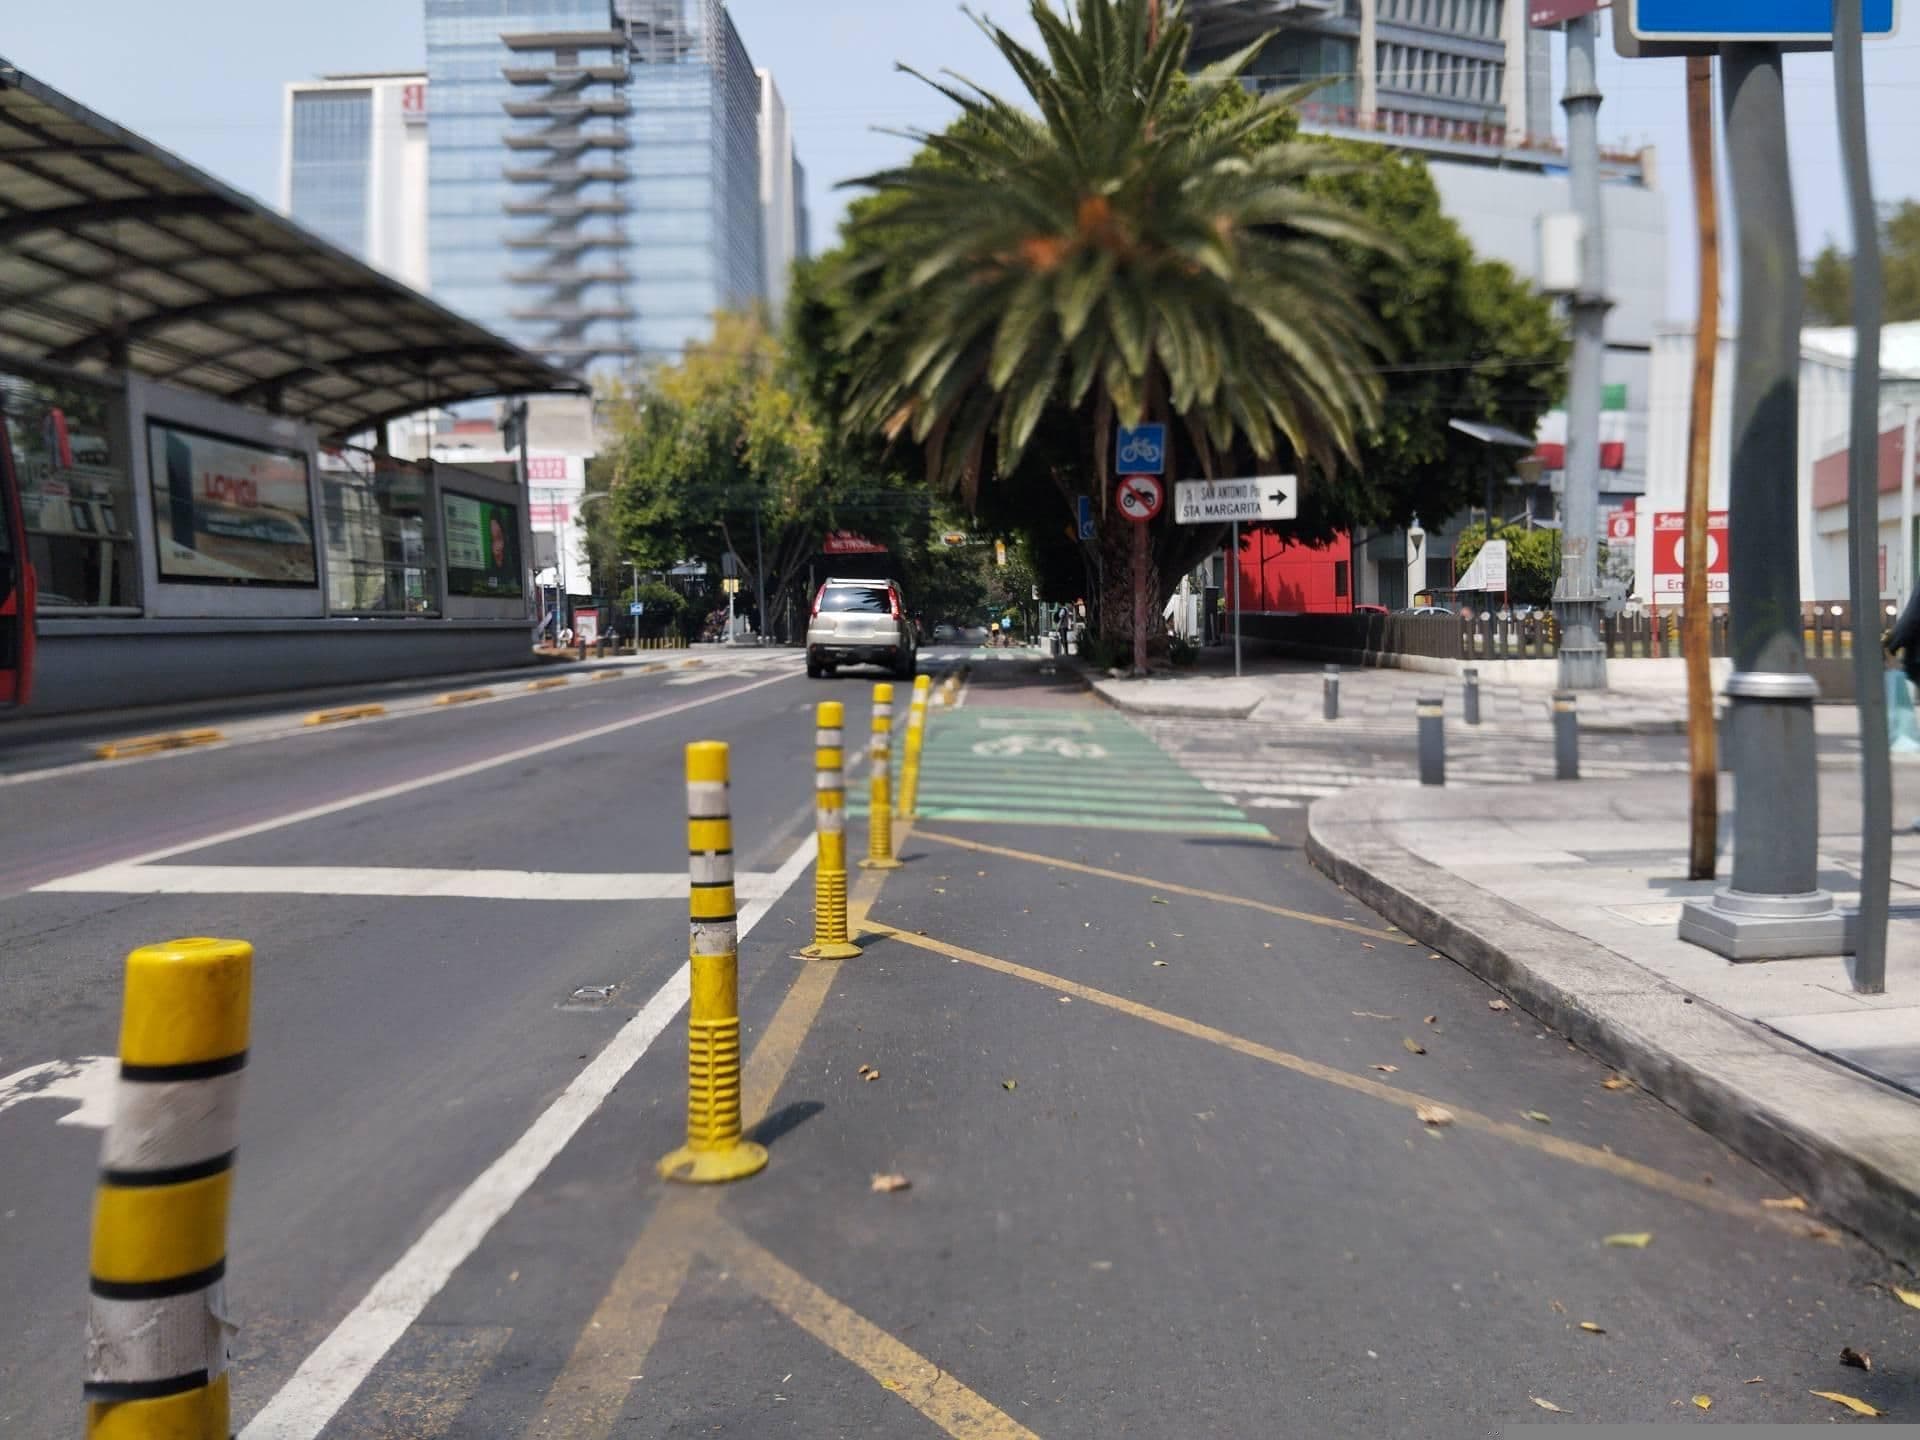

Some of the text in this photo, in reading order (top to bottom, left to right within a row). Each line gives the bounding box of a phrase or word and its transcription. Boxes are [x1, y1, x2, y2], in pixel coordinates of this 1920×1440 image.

[1183, 501, 1262, 518] STA MARGARITA
[1667, 578, 1724, 590] Enda
